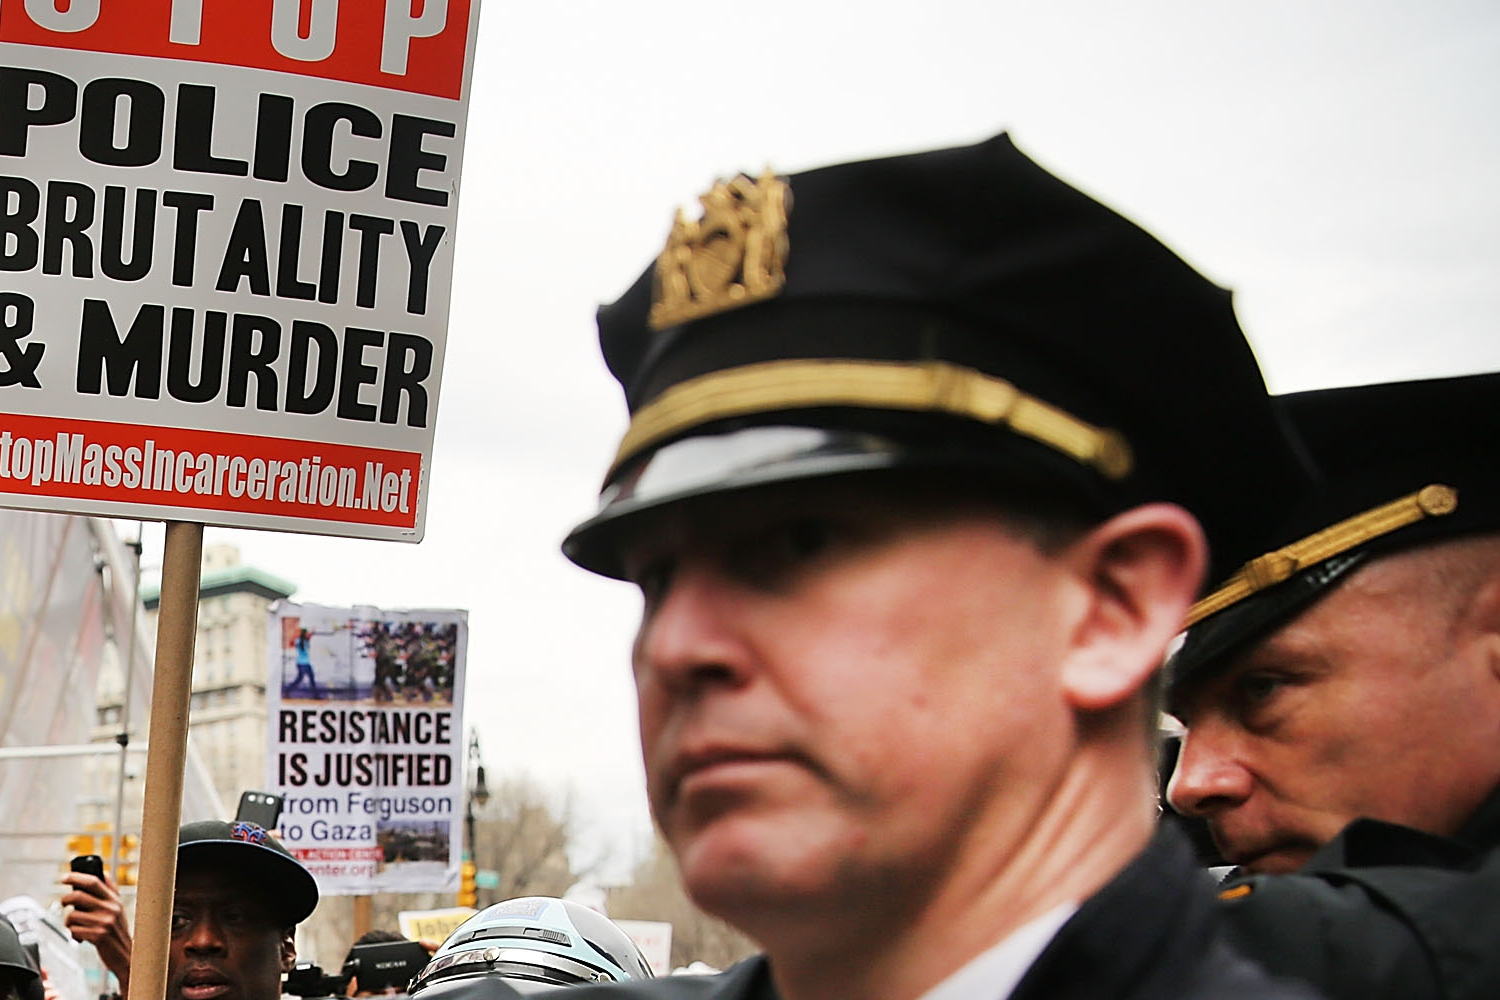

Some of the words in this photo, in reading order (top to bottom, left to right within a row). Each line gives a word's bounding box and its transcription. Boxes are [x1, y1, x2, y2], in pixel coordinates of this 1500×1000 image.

[76, 298, 434, 428] MURDER
[279, 710, 451, 744] RESISTANCE
[279, 754, 308, 786] IS
[315, 754, 451, 786] JUSTIFIED
[280, 824, 302, 841] to
[311, 820, 372, 841] Gaza
